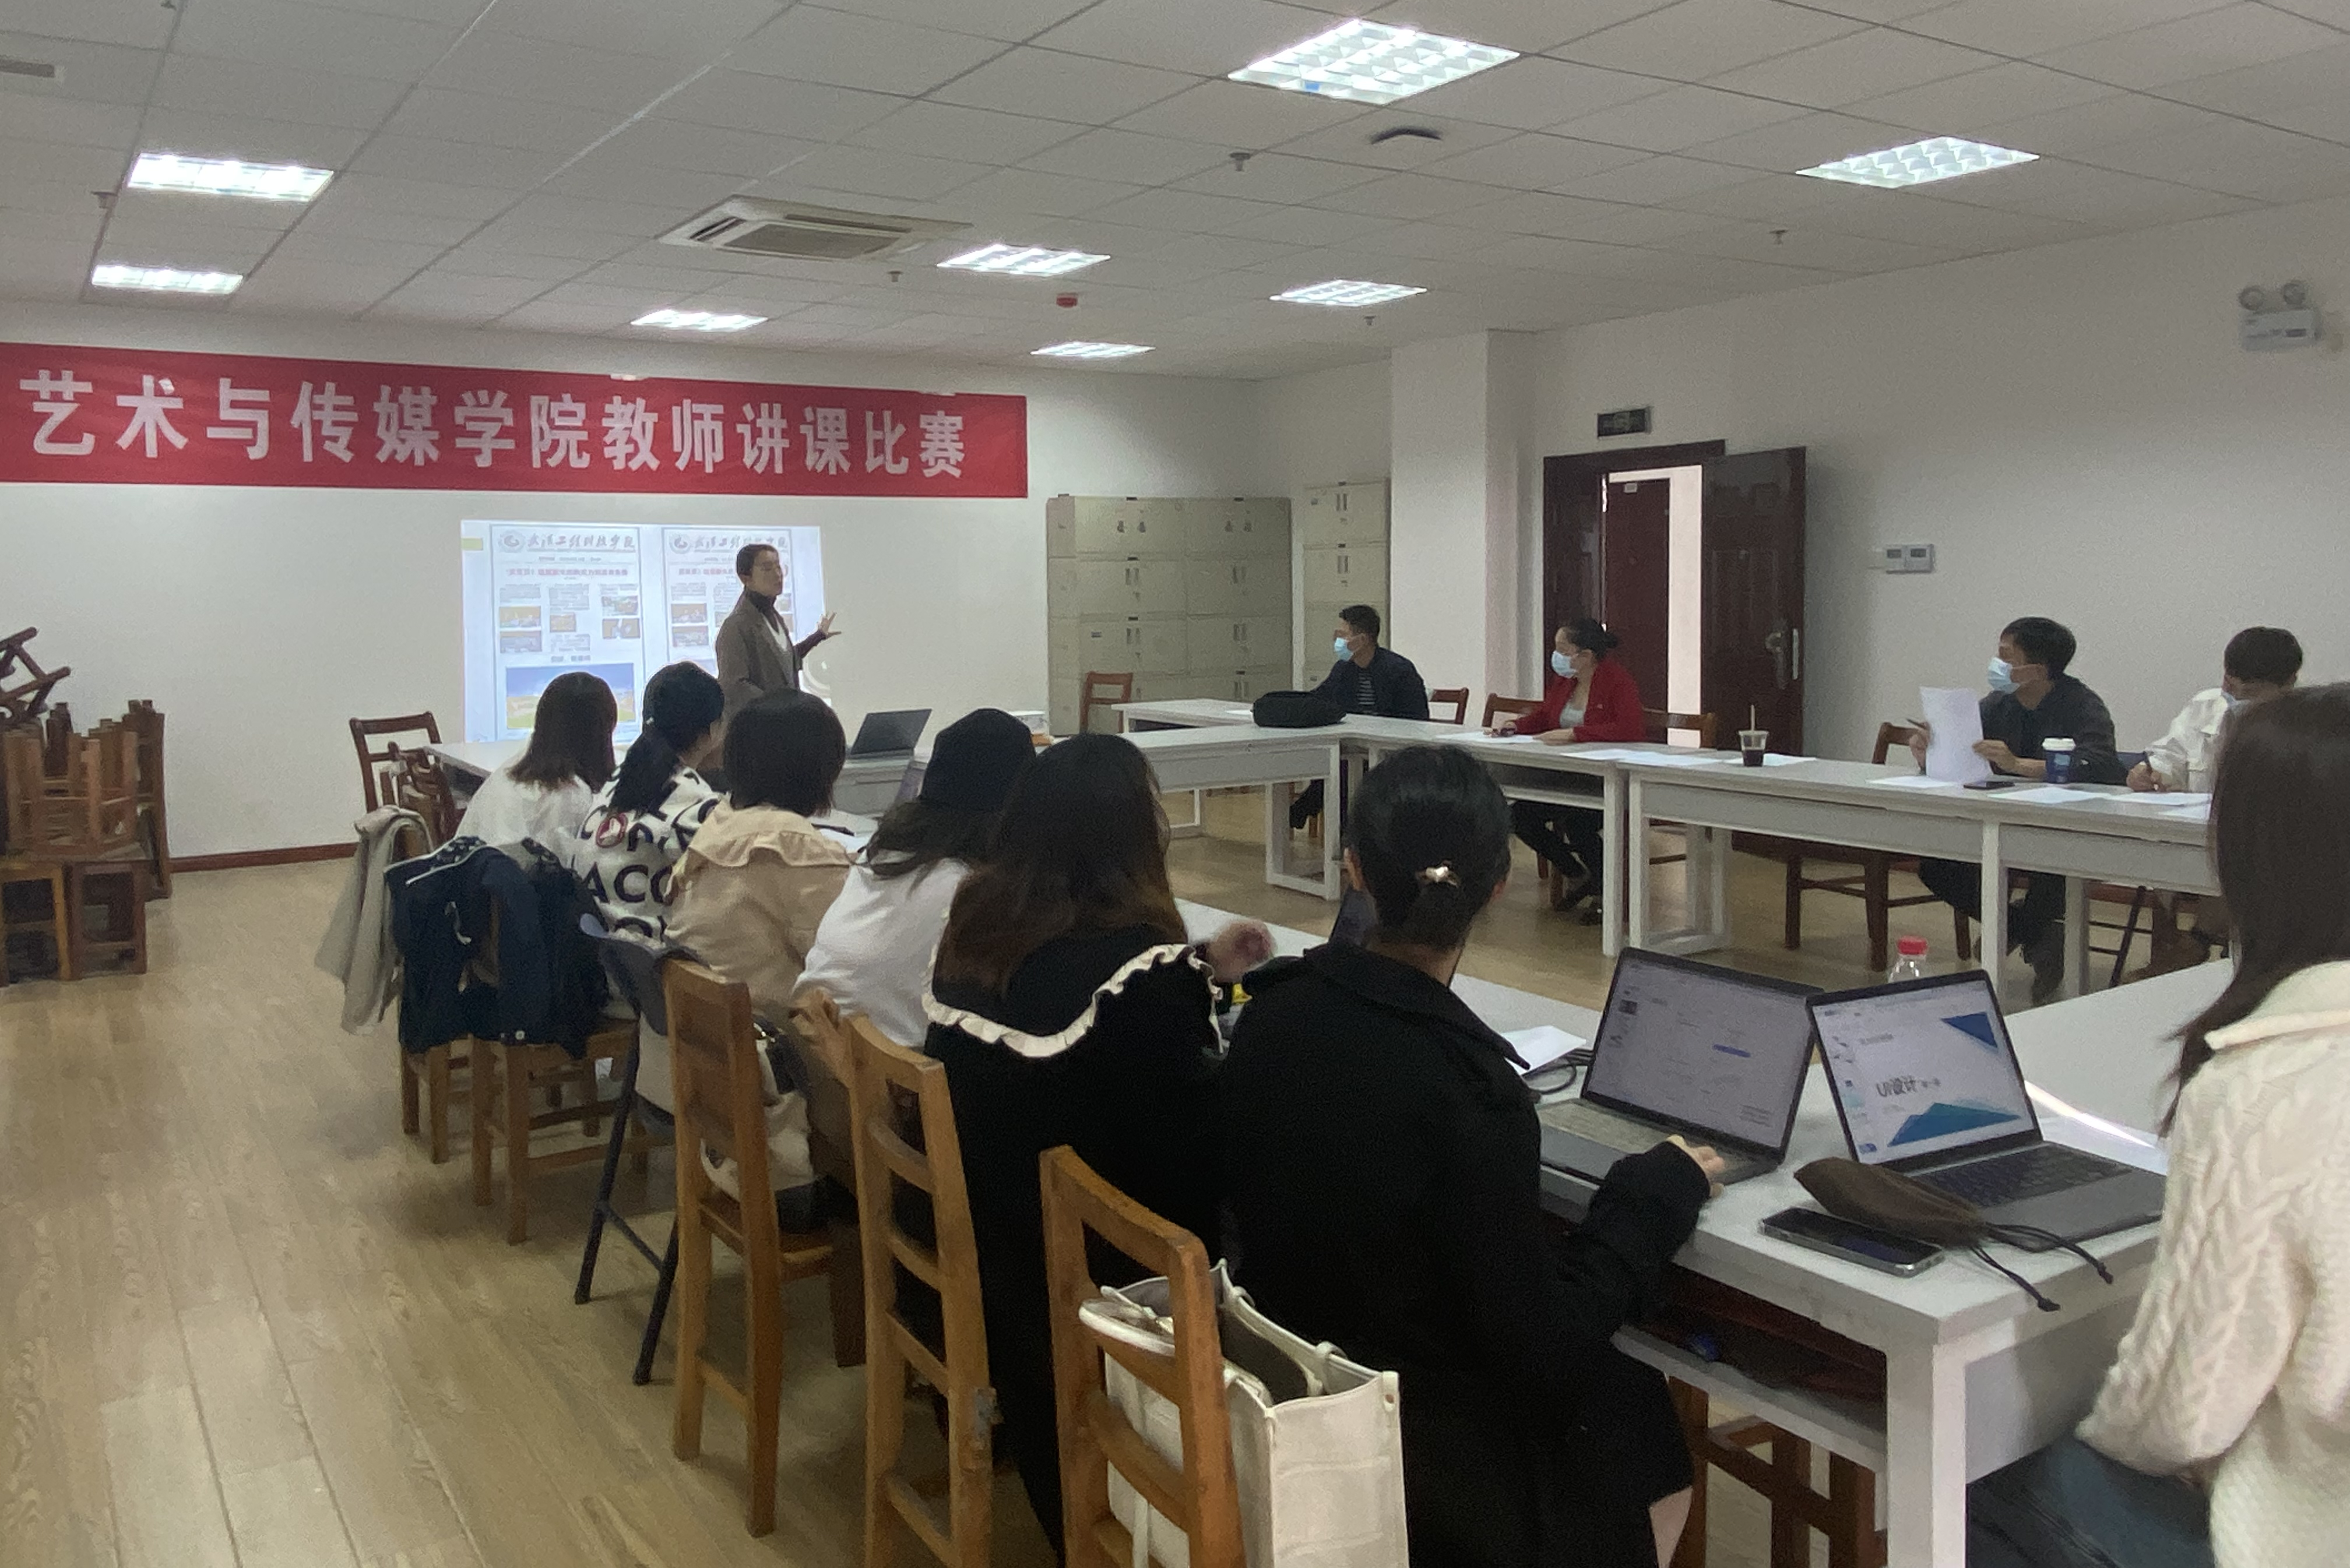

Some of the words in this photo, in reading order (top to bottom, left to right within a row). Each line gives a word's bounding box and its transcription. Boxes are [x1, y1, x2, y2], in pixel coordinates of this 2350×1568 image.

[19, 369, 965, 478] 艺术与传媒学院教师讲课比赛
